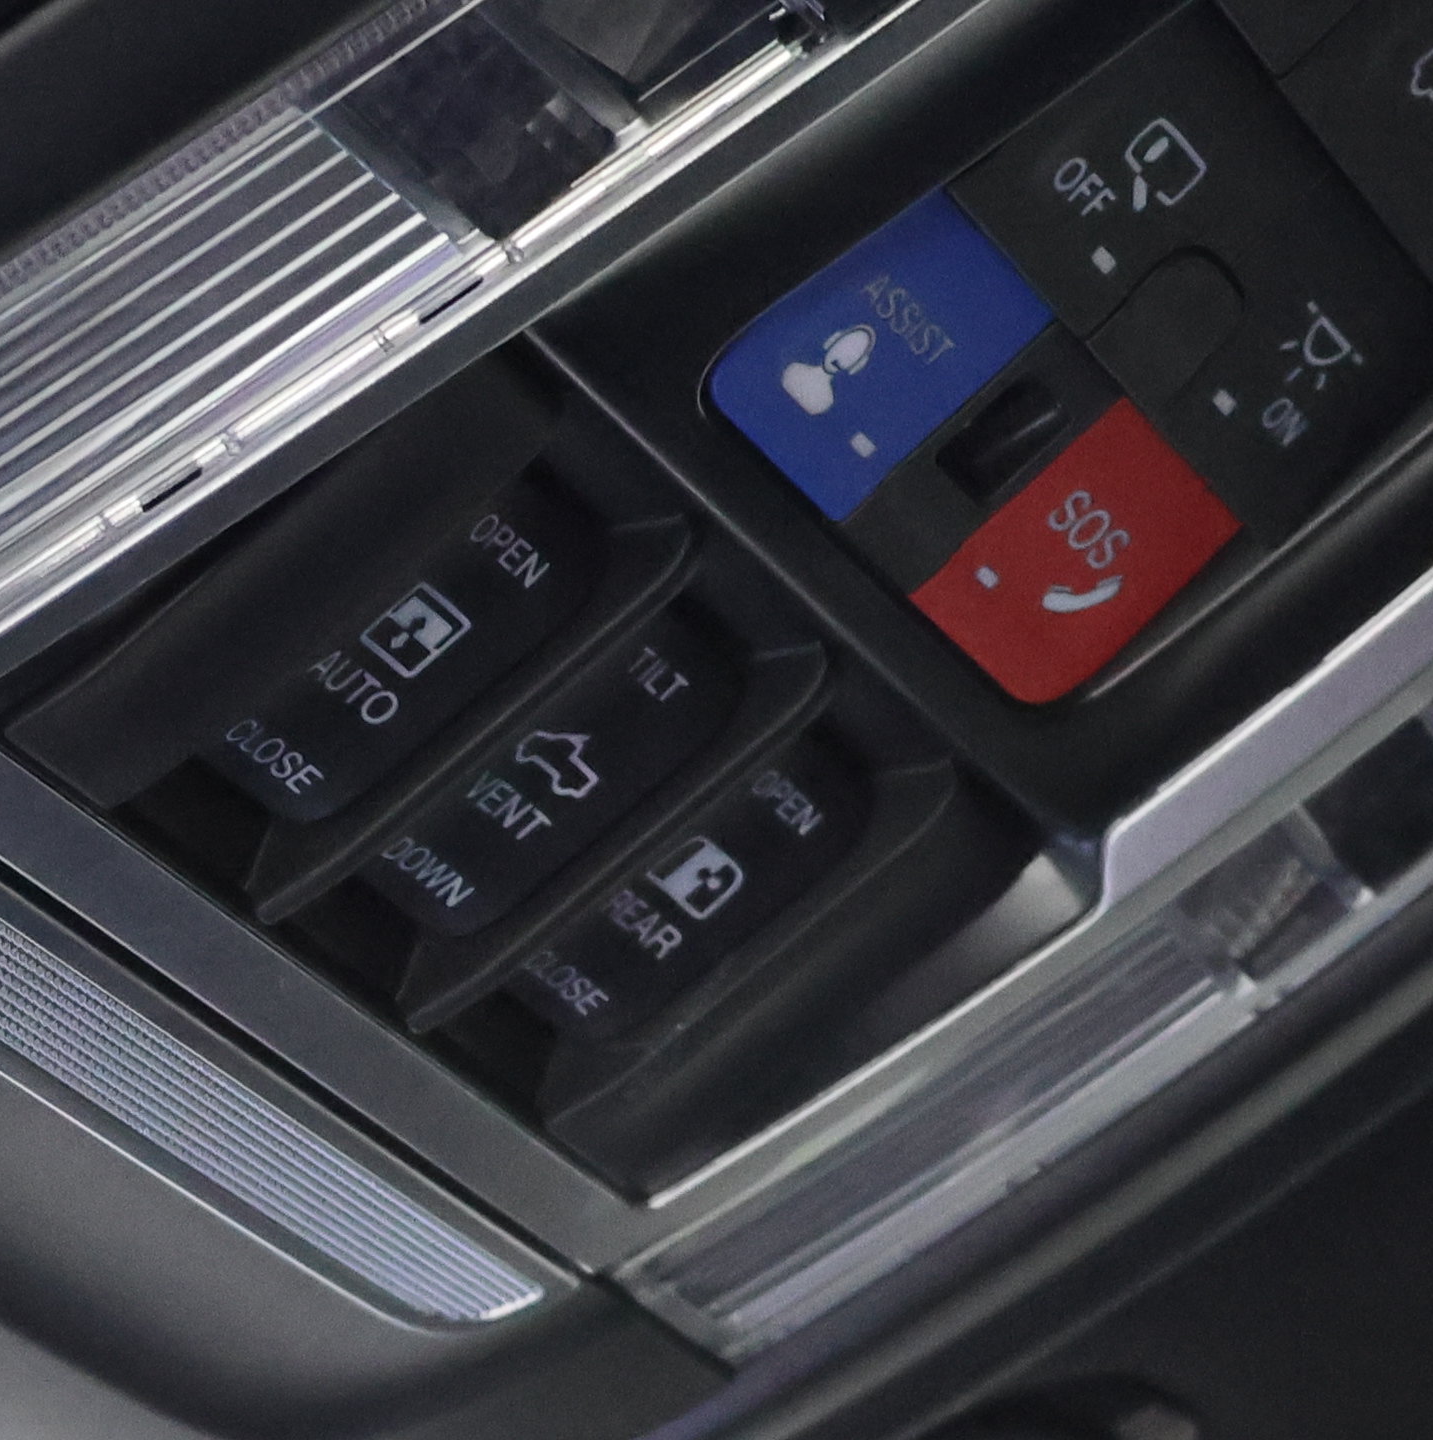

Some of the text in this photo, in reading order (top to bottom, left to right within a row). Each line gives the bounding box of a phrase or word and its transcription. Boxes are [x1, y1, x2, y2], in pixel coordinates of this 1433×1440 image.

[1053, 157, 1116, 216] OFF
[861, 273, 956, 364] ASSIST
[1261, 397, 1309, 448] ON
[470, 513, 551, 589] OPEN
[1047, 489, 1131, 570] SOS
[307, 650, 399, 725] AUTO
[628, 646, 690, 703] TILT
[225, 718, 325, 795] CLOSE
[466, 770, 553, 841] VENT
[751, 770, 824, 837] OPEN
[381, 836, 475, 908] DOWN
[609, 888, 683, 960] REAR
[522, 949, 610, 1016] CLOSE
